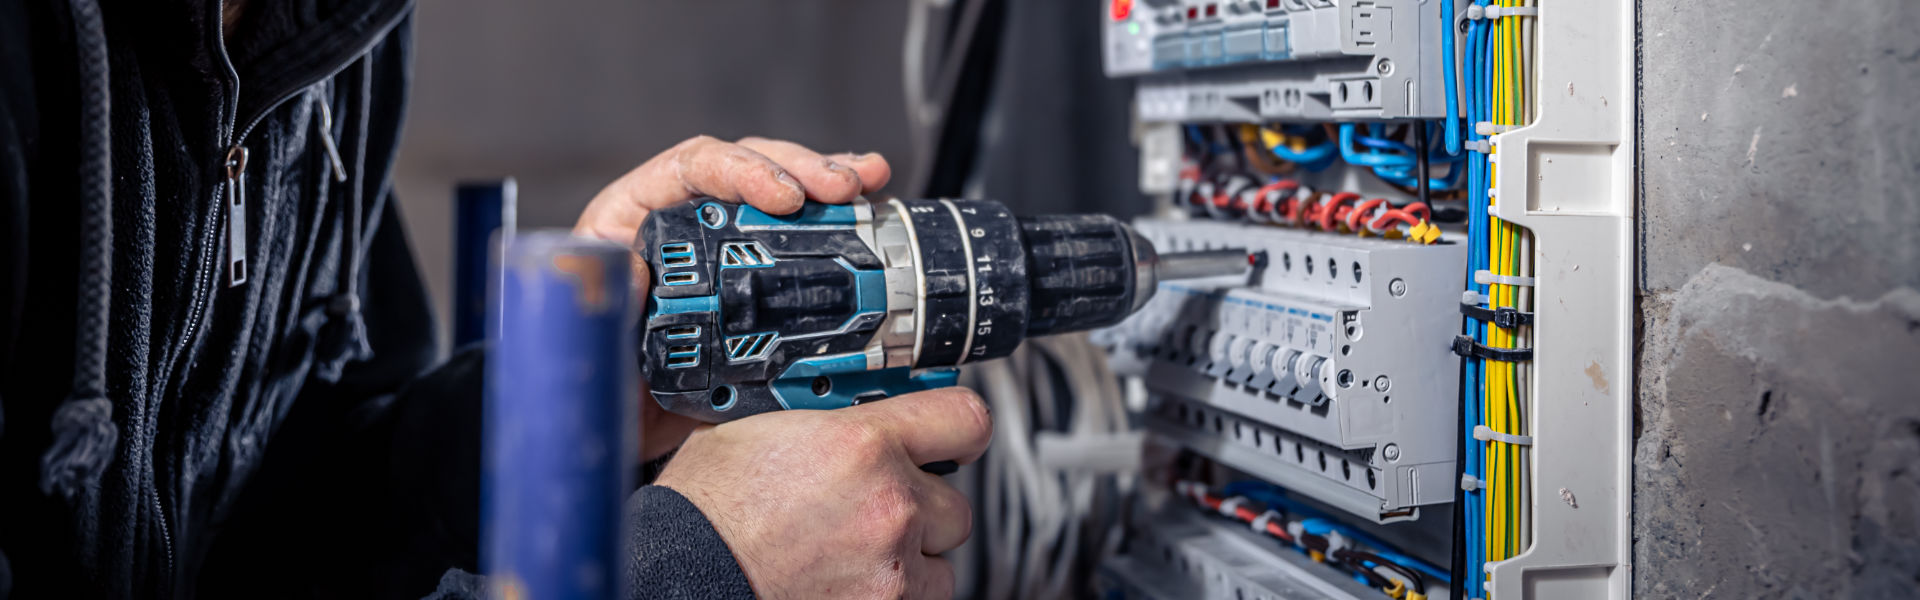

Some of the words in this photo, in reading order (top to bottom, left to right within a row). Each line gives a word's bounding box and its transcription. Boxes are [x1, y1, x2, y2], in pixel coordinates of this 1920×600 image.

[962, 207, 977, 215] 7
[970, 228, 985, 238] 9
[977, 254, 992, 273] 11
[980, 287, 994, 306] 13
[977, 319, 992, 336] 15
[972, 345, 986, 356] 17
